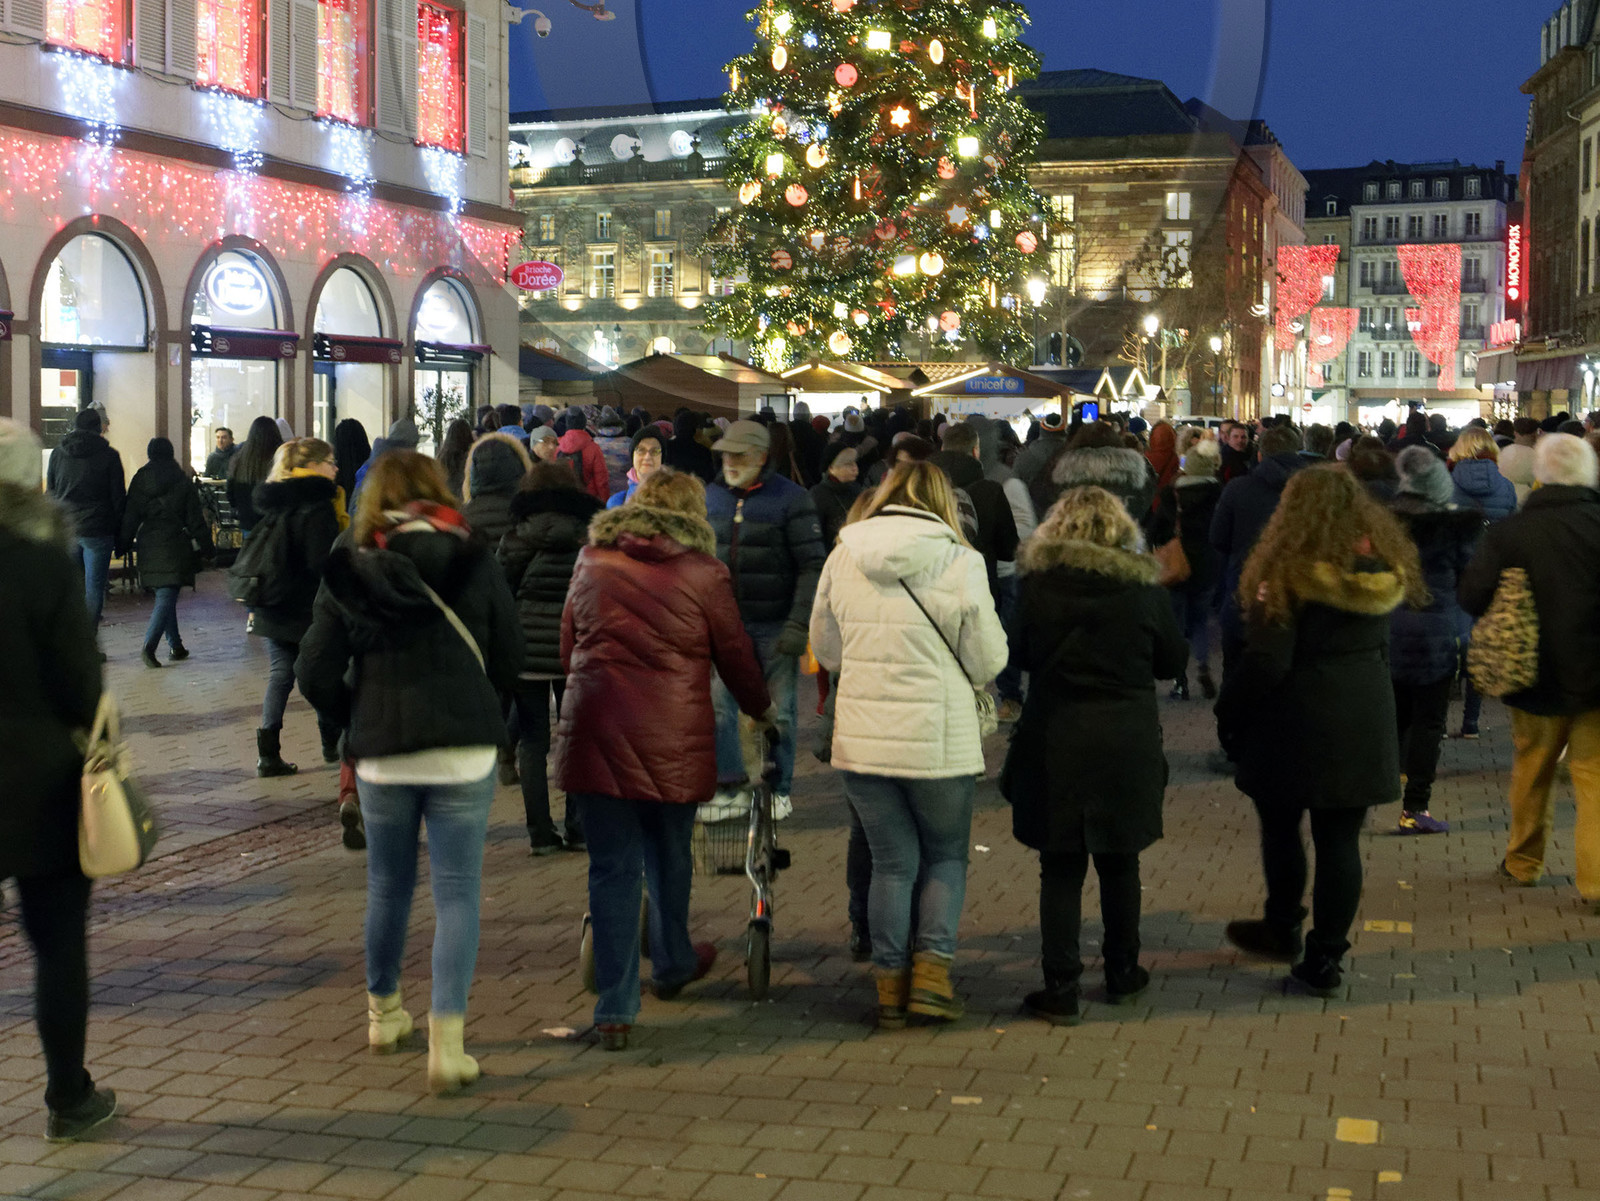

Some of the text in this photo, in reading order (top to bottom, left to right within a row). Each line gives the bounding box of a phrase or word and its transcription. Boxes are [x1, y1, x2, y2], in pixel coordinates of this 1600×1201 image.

[1508, 224, 1520, 286] MONOPRIX
[525, 265, 552, 273] Brioche
[519, 272, 557, 286] Dorée
[970, 378, 1005, 390] unicef
